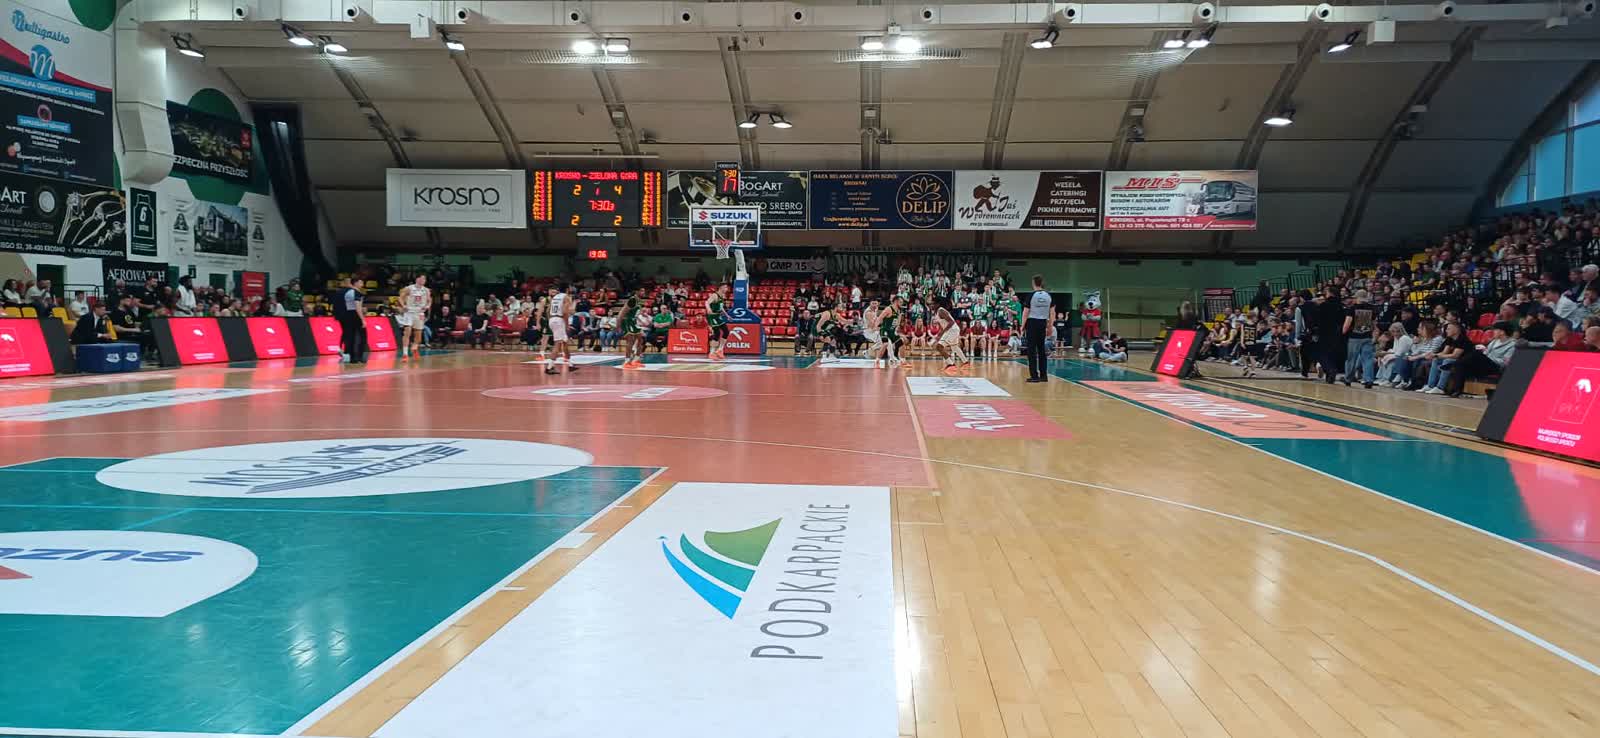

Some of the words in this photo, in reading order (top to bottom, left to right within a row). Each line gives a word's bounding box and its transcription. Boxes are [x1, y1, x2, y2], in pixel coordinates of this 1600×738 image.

[173, 155, 209, 169] EZPIECZNA
[555, 172, 581, 180] KROSNO
[589, 172, 618, 180] ZIELONA
[572, 184, 582, 196] 2
[613, 184, 622, 195] 4
[723, 178, 737, 192] 17
[0, 186, 27, 205] ART
[595, 187, 600, 196] 1
[770, 202, 803, 211] SREBRO
[902, 201, 947, 214] DELIP
[139, 206, 148, 222] 6
[711, 211, 752, 219] SUZUKI
[571, 215, 580, 226] 2
[613, 215, 622, 226] 2
[107, 269, 166, 282] AEROWATH
[0, 548, 204, 562] SUZ
[750, 504, 850, 660] PODKARPACKIE
